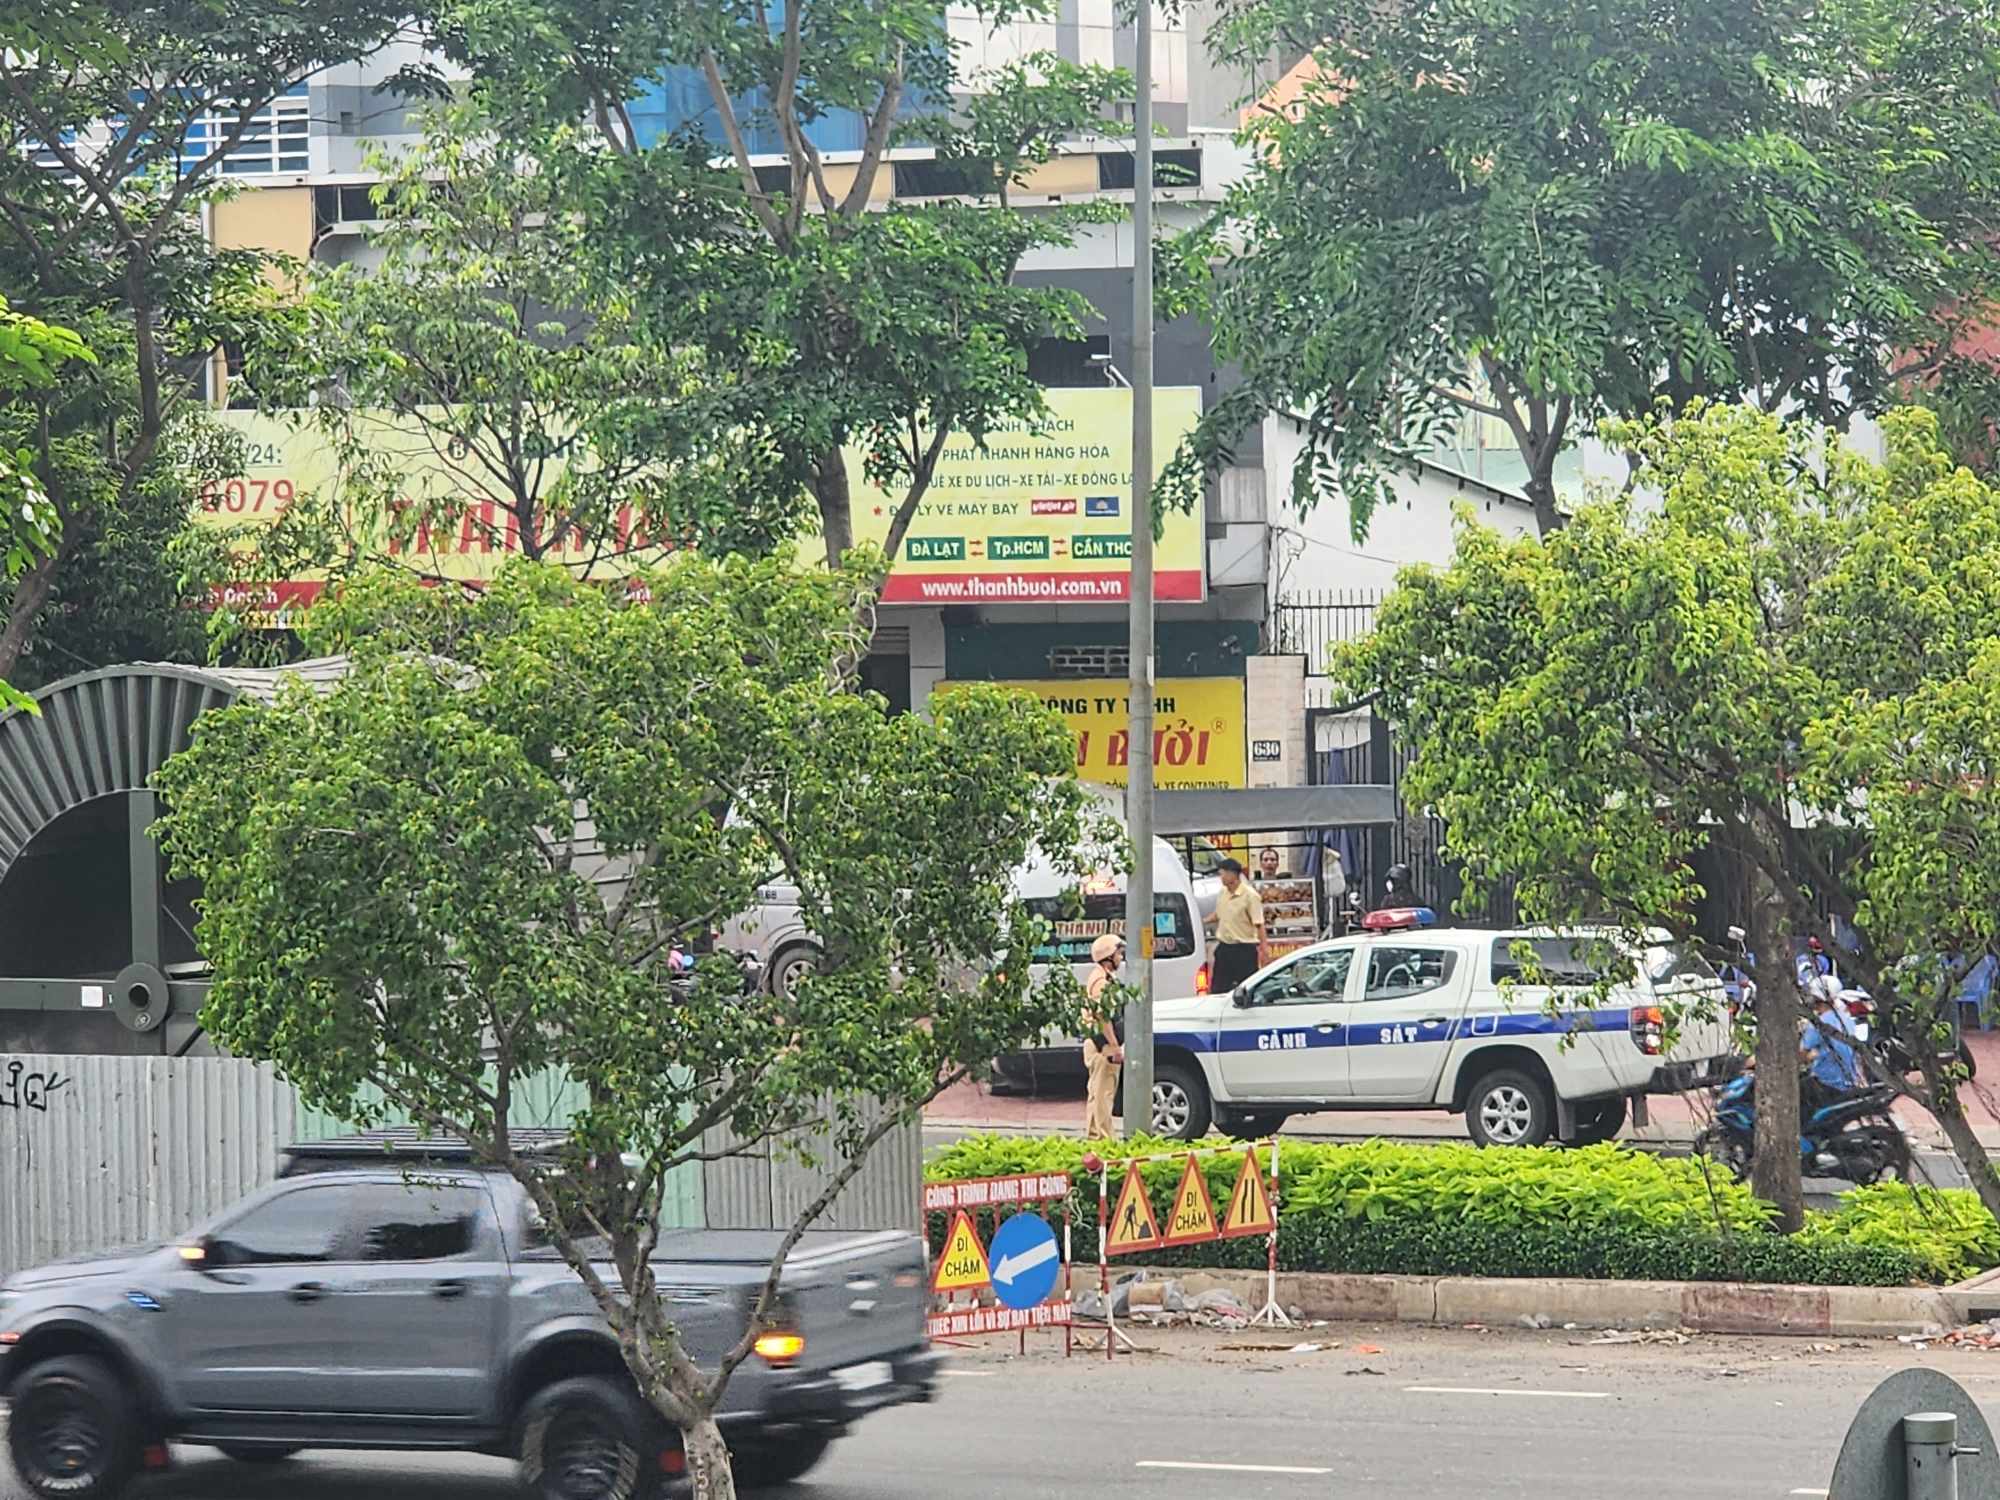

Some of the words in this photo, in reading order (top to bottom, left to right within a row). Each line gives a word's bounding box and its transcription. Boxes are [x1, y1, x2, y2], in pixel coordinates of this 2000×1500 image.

[948, 475, 963, 488] XE
[966, 475, 982, 488] DU
[992, 502, 1019, 516] BAY
[911, 541, 930, 557] ĐÀ
[935, 541, 960, 559] LẠT
[994, 540, 1044, 558] Tp.HCM
[922, 576, 1122, 596] www.thanhbuoi.com.vn
[1040, 695, 1088, 714] ÔNG
[1093, 697, 1116, 714] TY
[1123, 697, 1176, 713] THH
[1254, 742, 1279, 757] 630
[1258, 1028, 1308, 1050] CẢNH
[1380, 1023, 1418, 1044] SÁT
[1039, 1173, 1067, 1197] CÔNG
